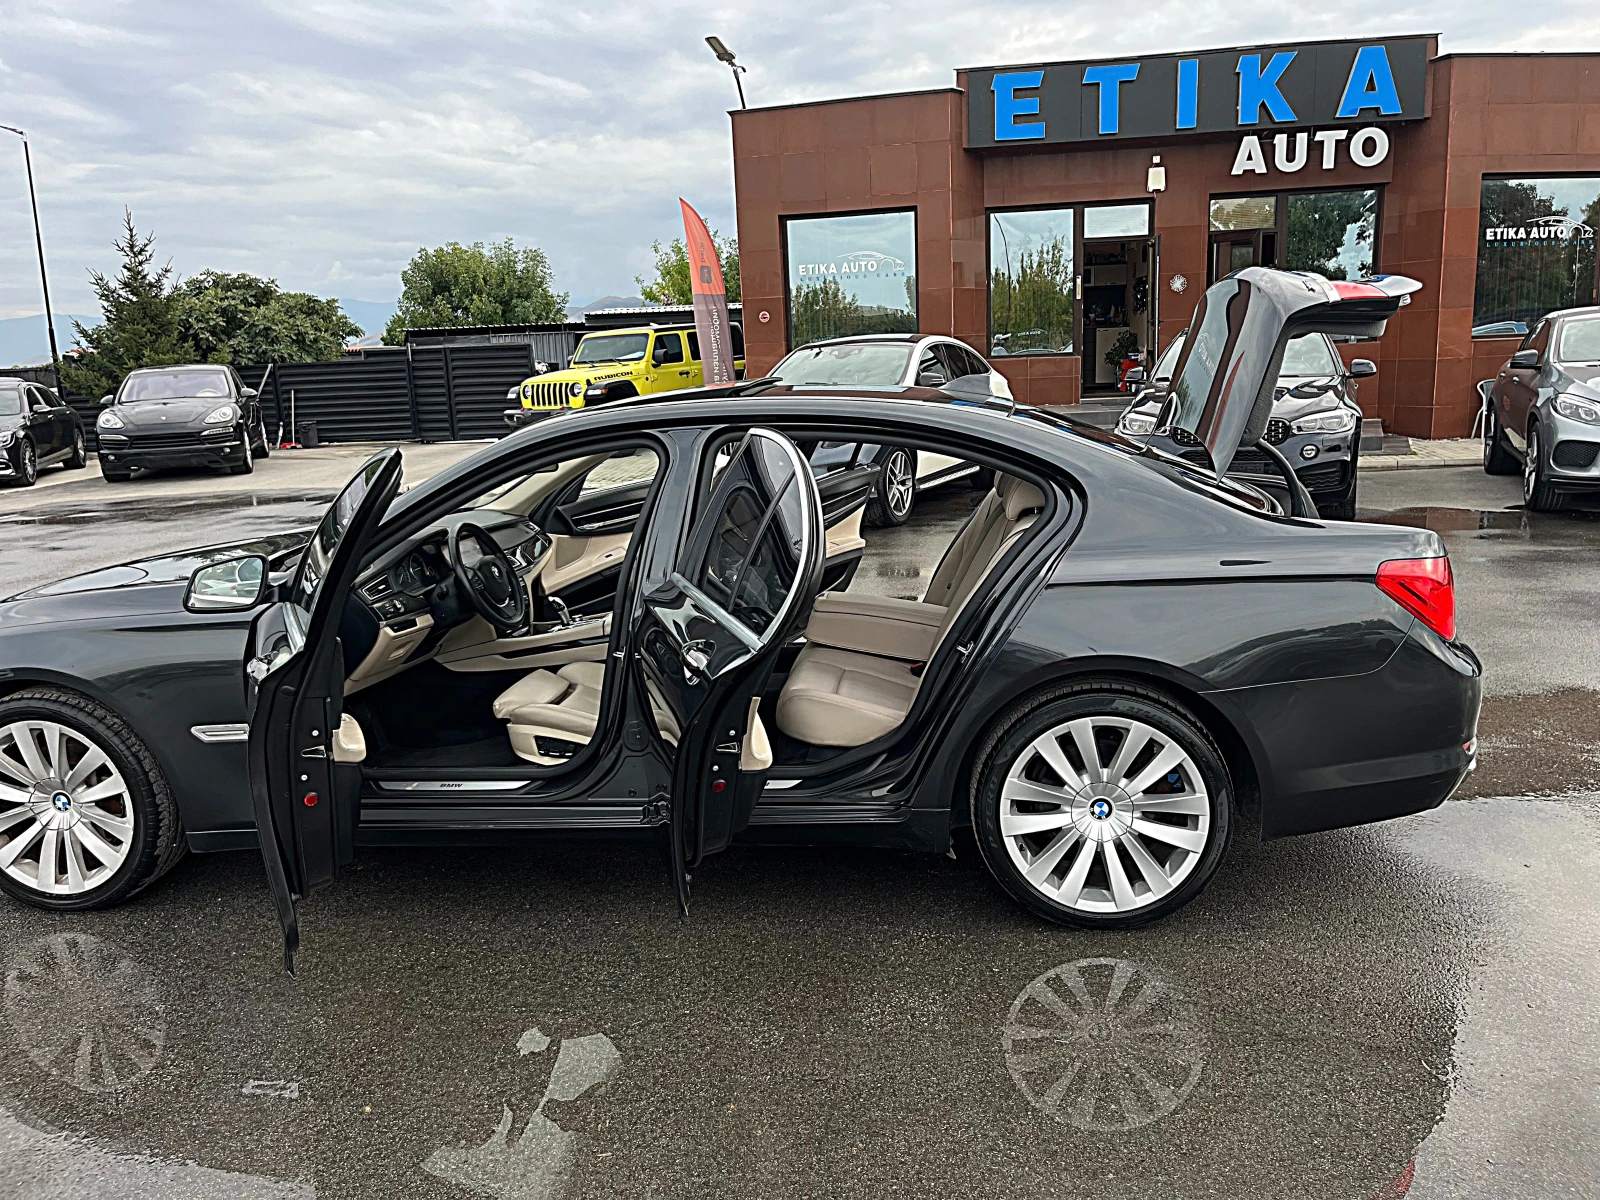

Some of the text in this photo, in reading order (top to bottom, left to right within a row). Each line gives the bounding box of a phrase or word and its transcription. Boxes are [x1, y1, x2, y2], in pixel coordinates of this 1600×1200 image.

[991, 45, 1402, 141] ETIKA
[1231, 126, 1390, 176] AUTO
[1485, 226, 1567, 240] ETIKA AUTO
[798, 260, 878, 276] ETIKA AUTO
[593, 371, 634, 381] RUBICON
